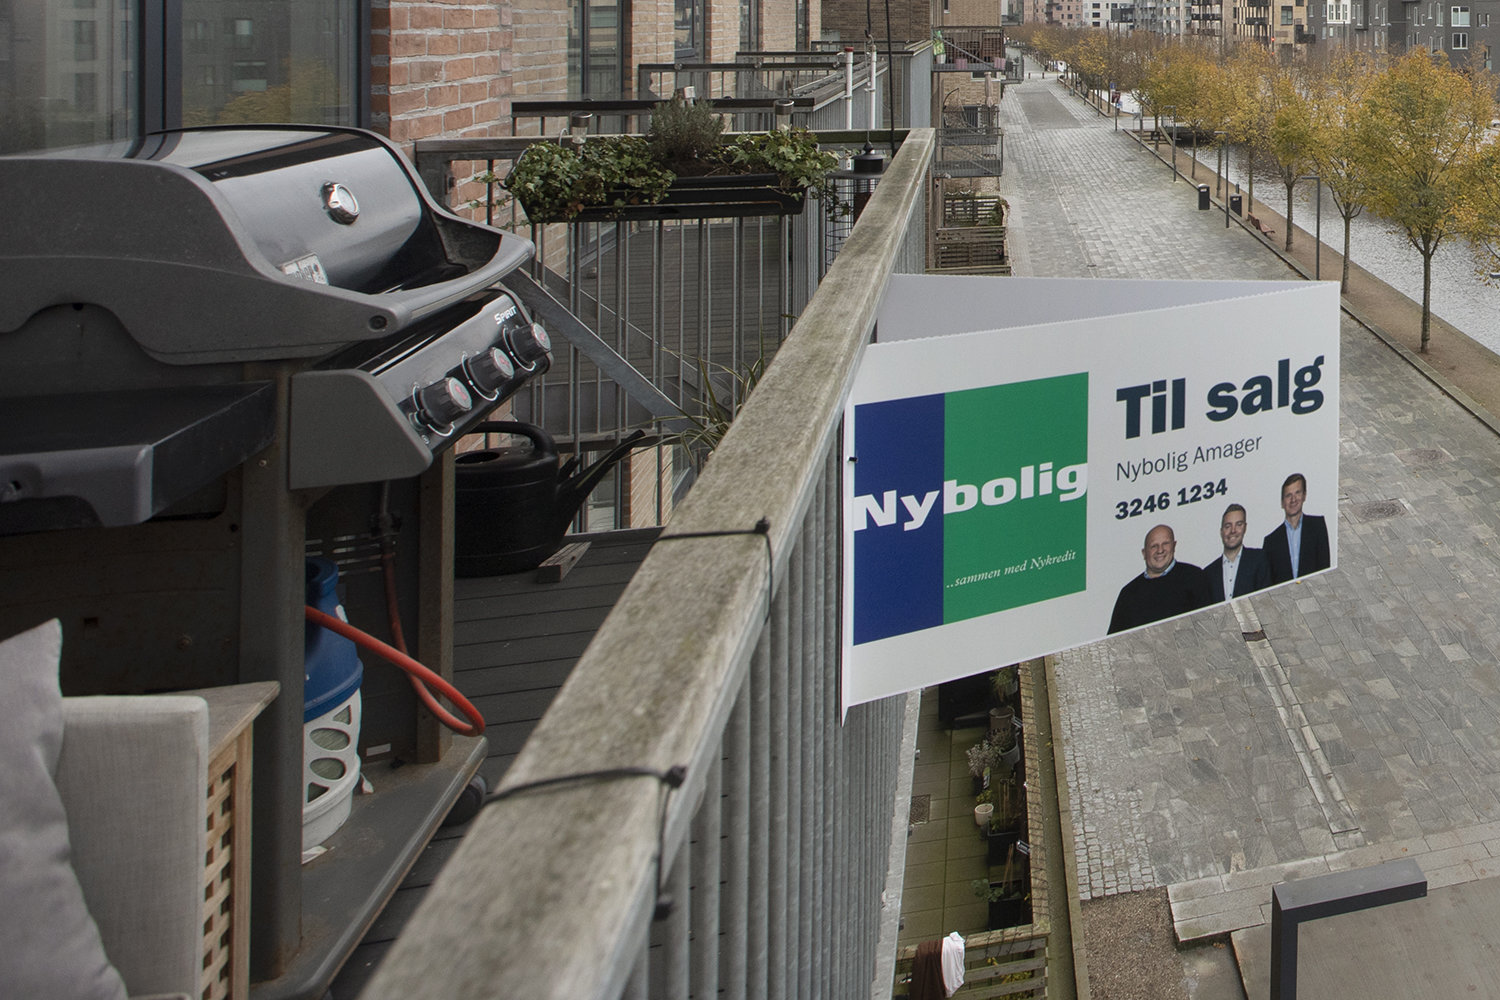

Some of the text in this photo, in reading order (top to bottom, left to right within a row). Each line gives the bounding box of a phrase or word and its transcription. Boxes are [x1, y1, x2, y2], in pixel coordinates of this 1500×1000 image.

[494, 305, 517, 325] SPIRIT
[1116, 355, 1324, 439] Til salg
[1116, 436, 1262, 482] Nybolig Amager
[853, 461, 1088, 532] Nybolig
[1115, 478, 1228, 520] 3246 1234
[1004, 561, 1028, 575] med
[1030, 550, 1076, 570] Nykredit
